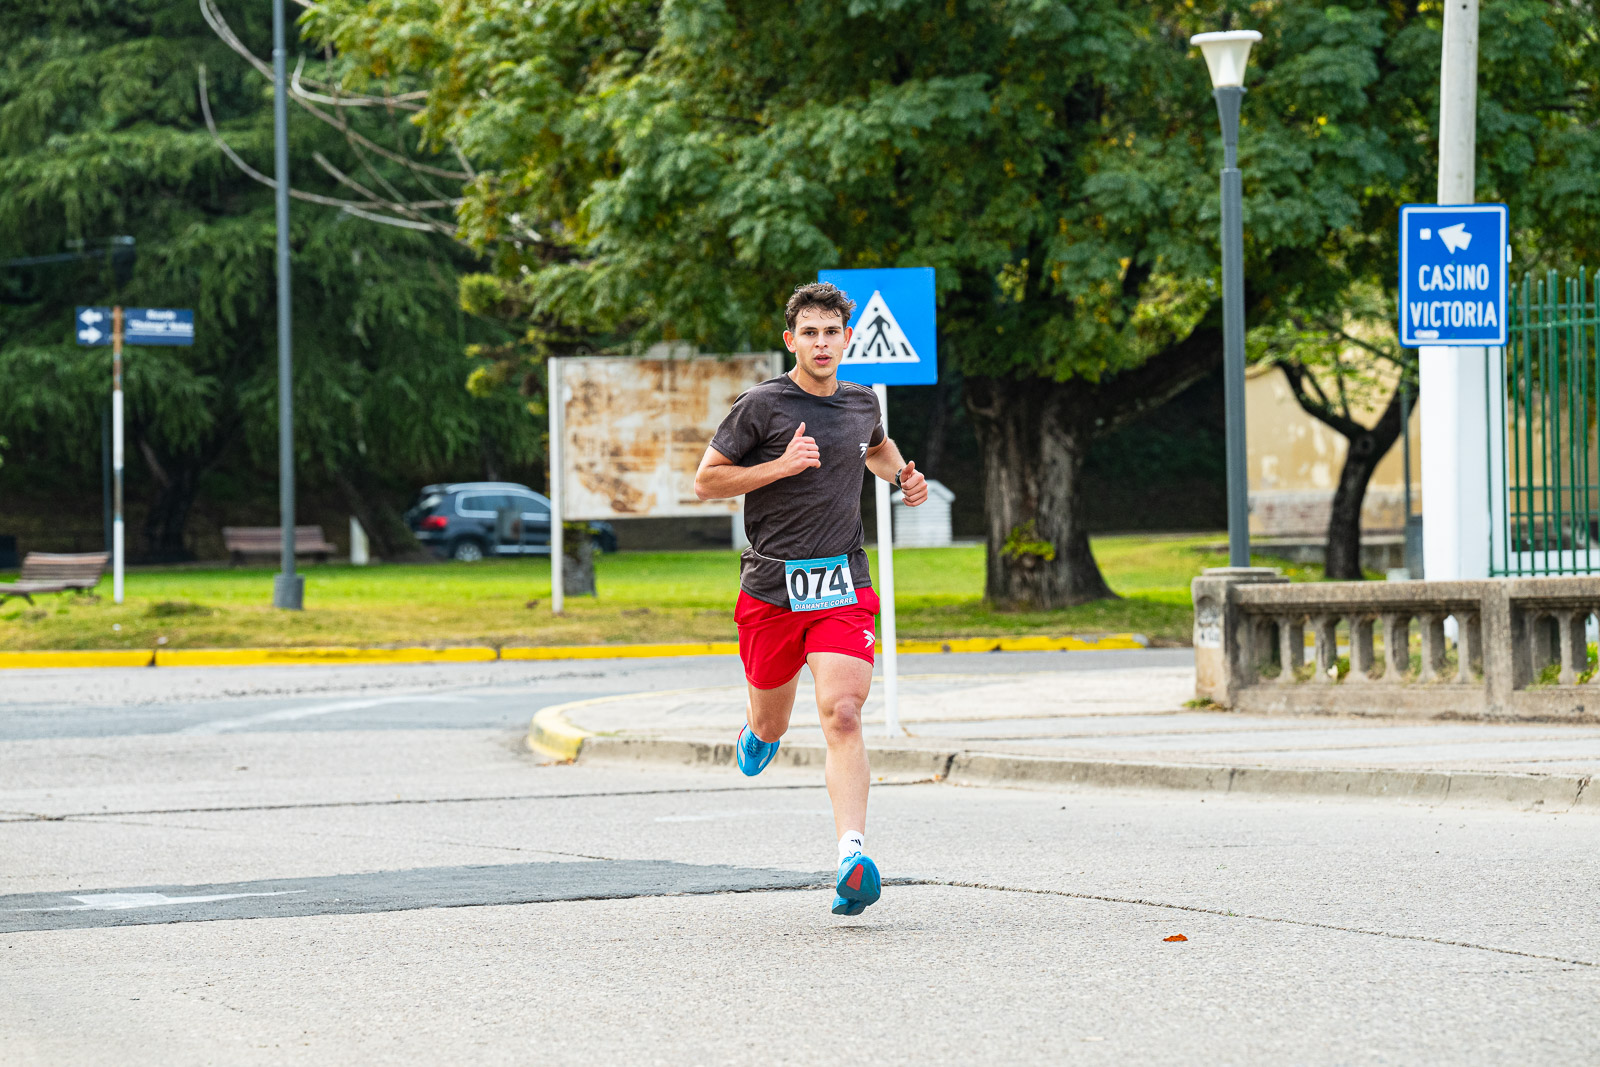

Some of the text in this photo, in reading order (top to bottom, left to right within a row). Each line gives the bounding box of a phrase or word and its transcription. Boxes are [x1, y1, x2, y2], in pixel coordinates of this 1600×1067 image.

[1418, 264, 1490, 292] CASINO
[1409, 301, 1498, 328] VICTORIA
[790, 564, 848, 602] 074
[794, 597, 854, 610] DIAMANTE CORRE
